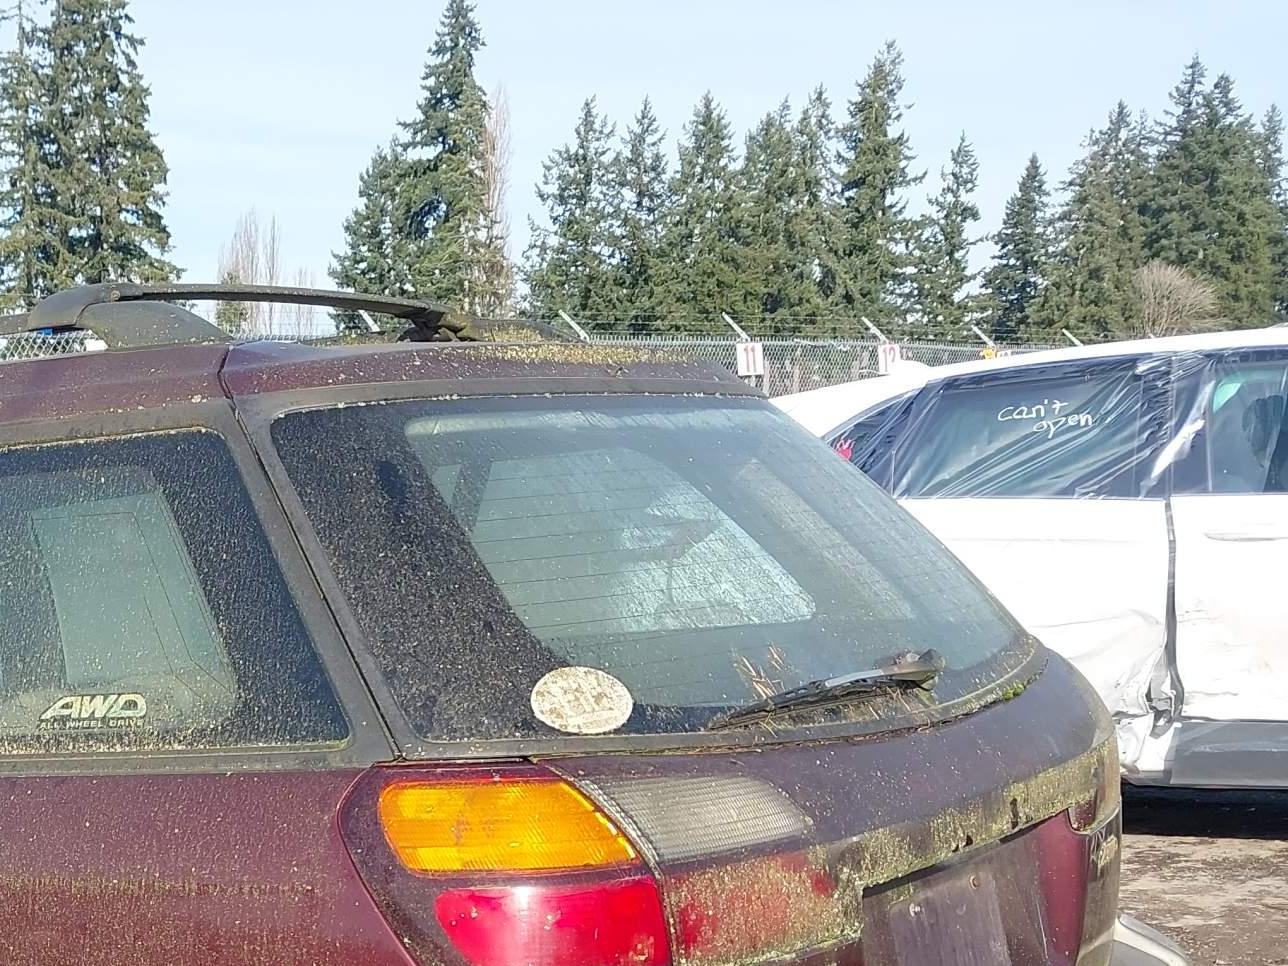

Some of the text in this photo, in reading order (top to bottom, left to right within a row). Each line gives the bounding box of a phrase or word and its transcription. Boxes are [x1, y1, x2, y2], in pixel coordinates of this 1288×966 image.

[743, 346, 758, 373] 11
[997, 398, 1069, 421] can't
[1032, 412, 1093, 439] open
[39, 692, 148, 720] AWD
[65, 720, 104, 730] WHEEL
[108, 718, 146, 728] DRIVE
